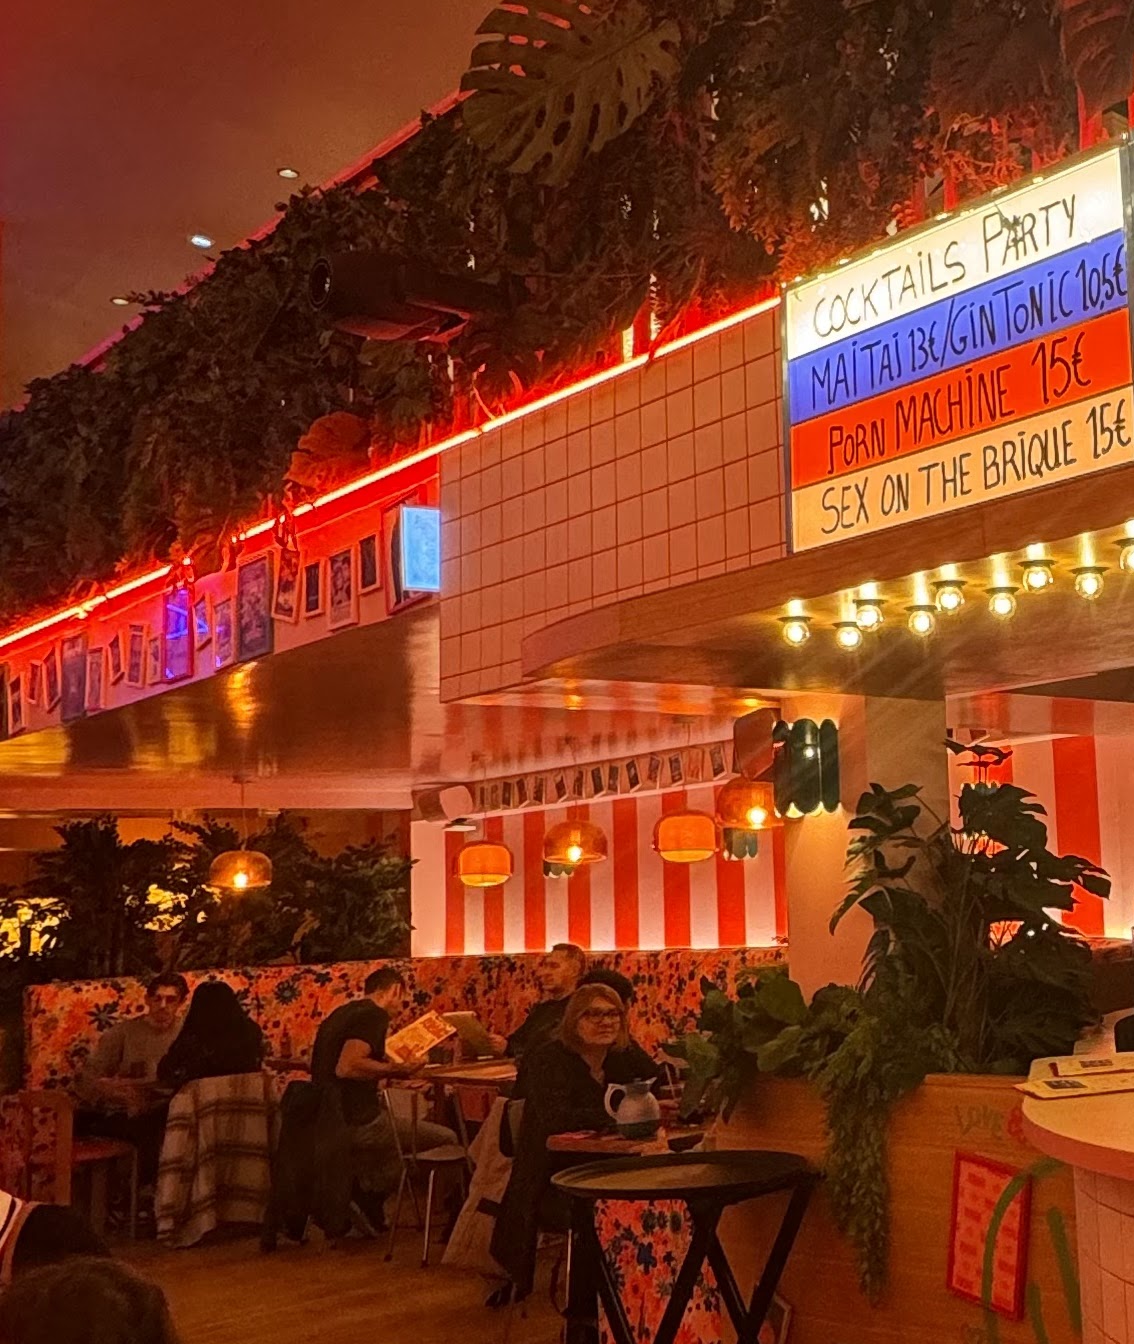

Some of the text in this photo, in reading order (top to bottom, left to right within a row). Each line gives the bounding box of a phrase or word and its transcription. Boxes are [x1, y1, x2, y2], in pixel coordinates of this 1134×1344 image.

[813, 241, 966, 338] COCKTAILS
[821, 398, 1132, 535] SEX ON THE BRIQUE 15€
[827, 332, 1092, 475] PORN MACHINE 15€
